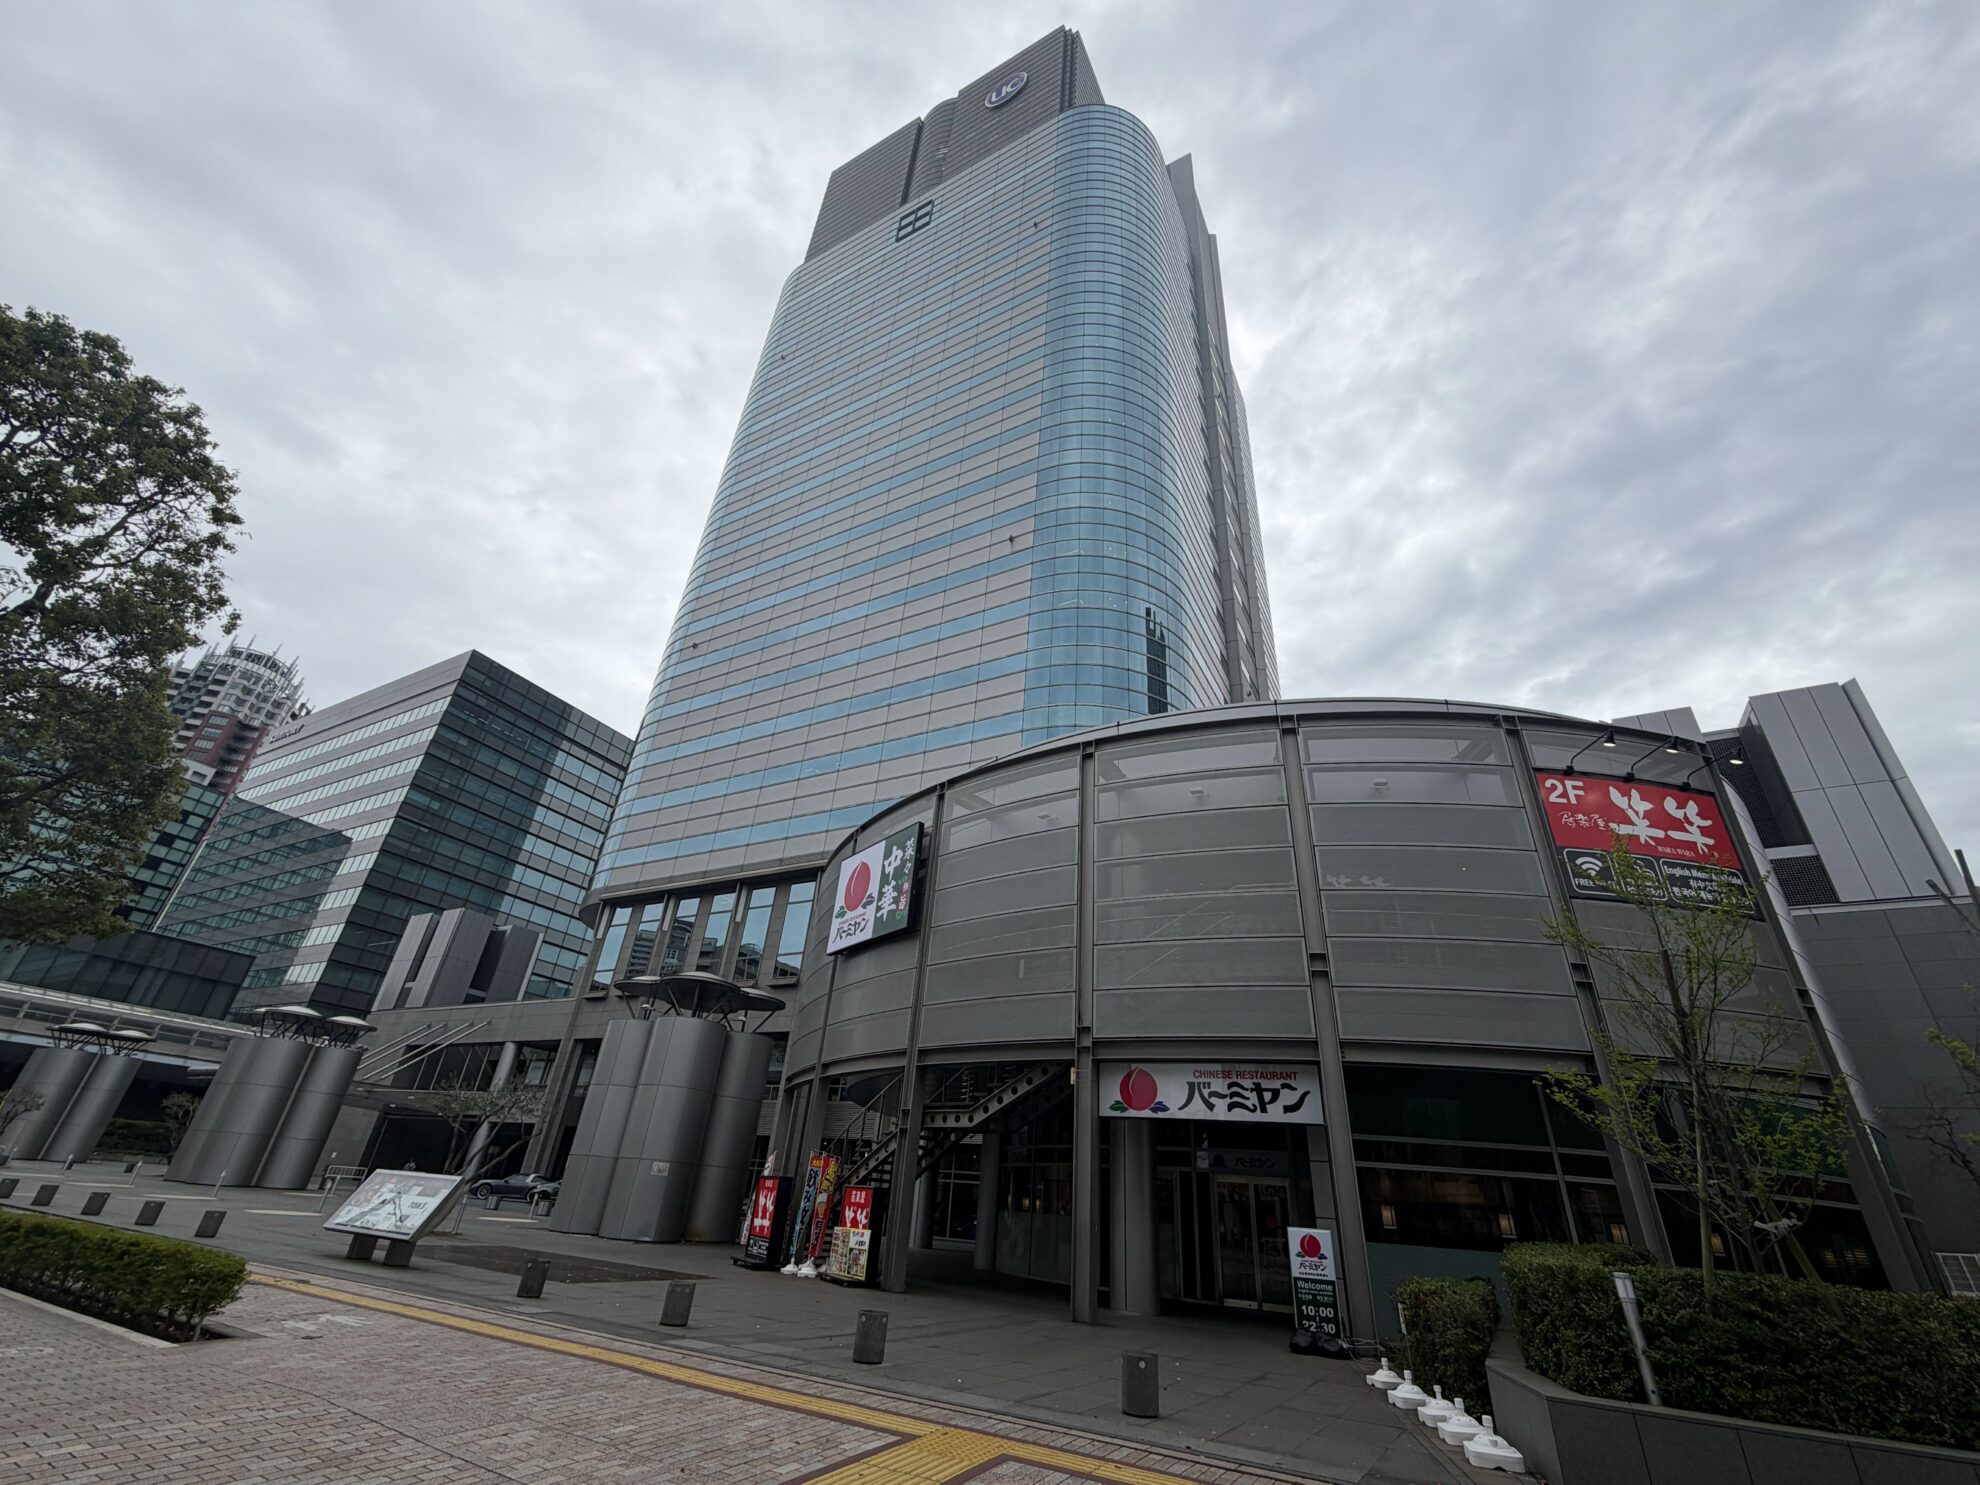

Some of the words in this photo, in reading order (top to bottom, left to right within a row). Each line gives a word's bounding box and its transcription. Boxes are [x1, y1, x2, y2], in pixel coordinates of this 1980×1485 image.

[1544, 778, 1586, 805] 2F
[1664, 865, 1691, 878] English
[877, 845, 904, 921] 中華
[1575, 877, 1596, 887] FREE
[832, 917, 870, 944] バーミヤン
[1192, 1069, 1232, 1080] CHINESE
[1235, 1071, 1298, 1082] RESTAURANT
[1177, 1080, 1311, 1115] バーミヤン
[1296, 1280, 1334, 1292] Welcome
[1301, 1304, 1335, 1319] 10:00
[1302, 1320, 1337, 1335] 22:30
